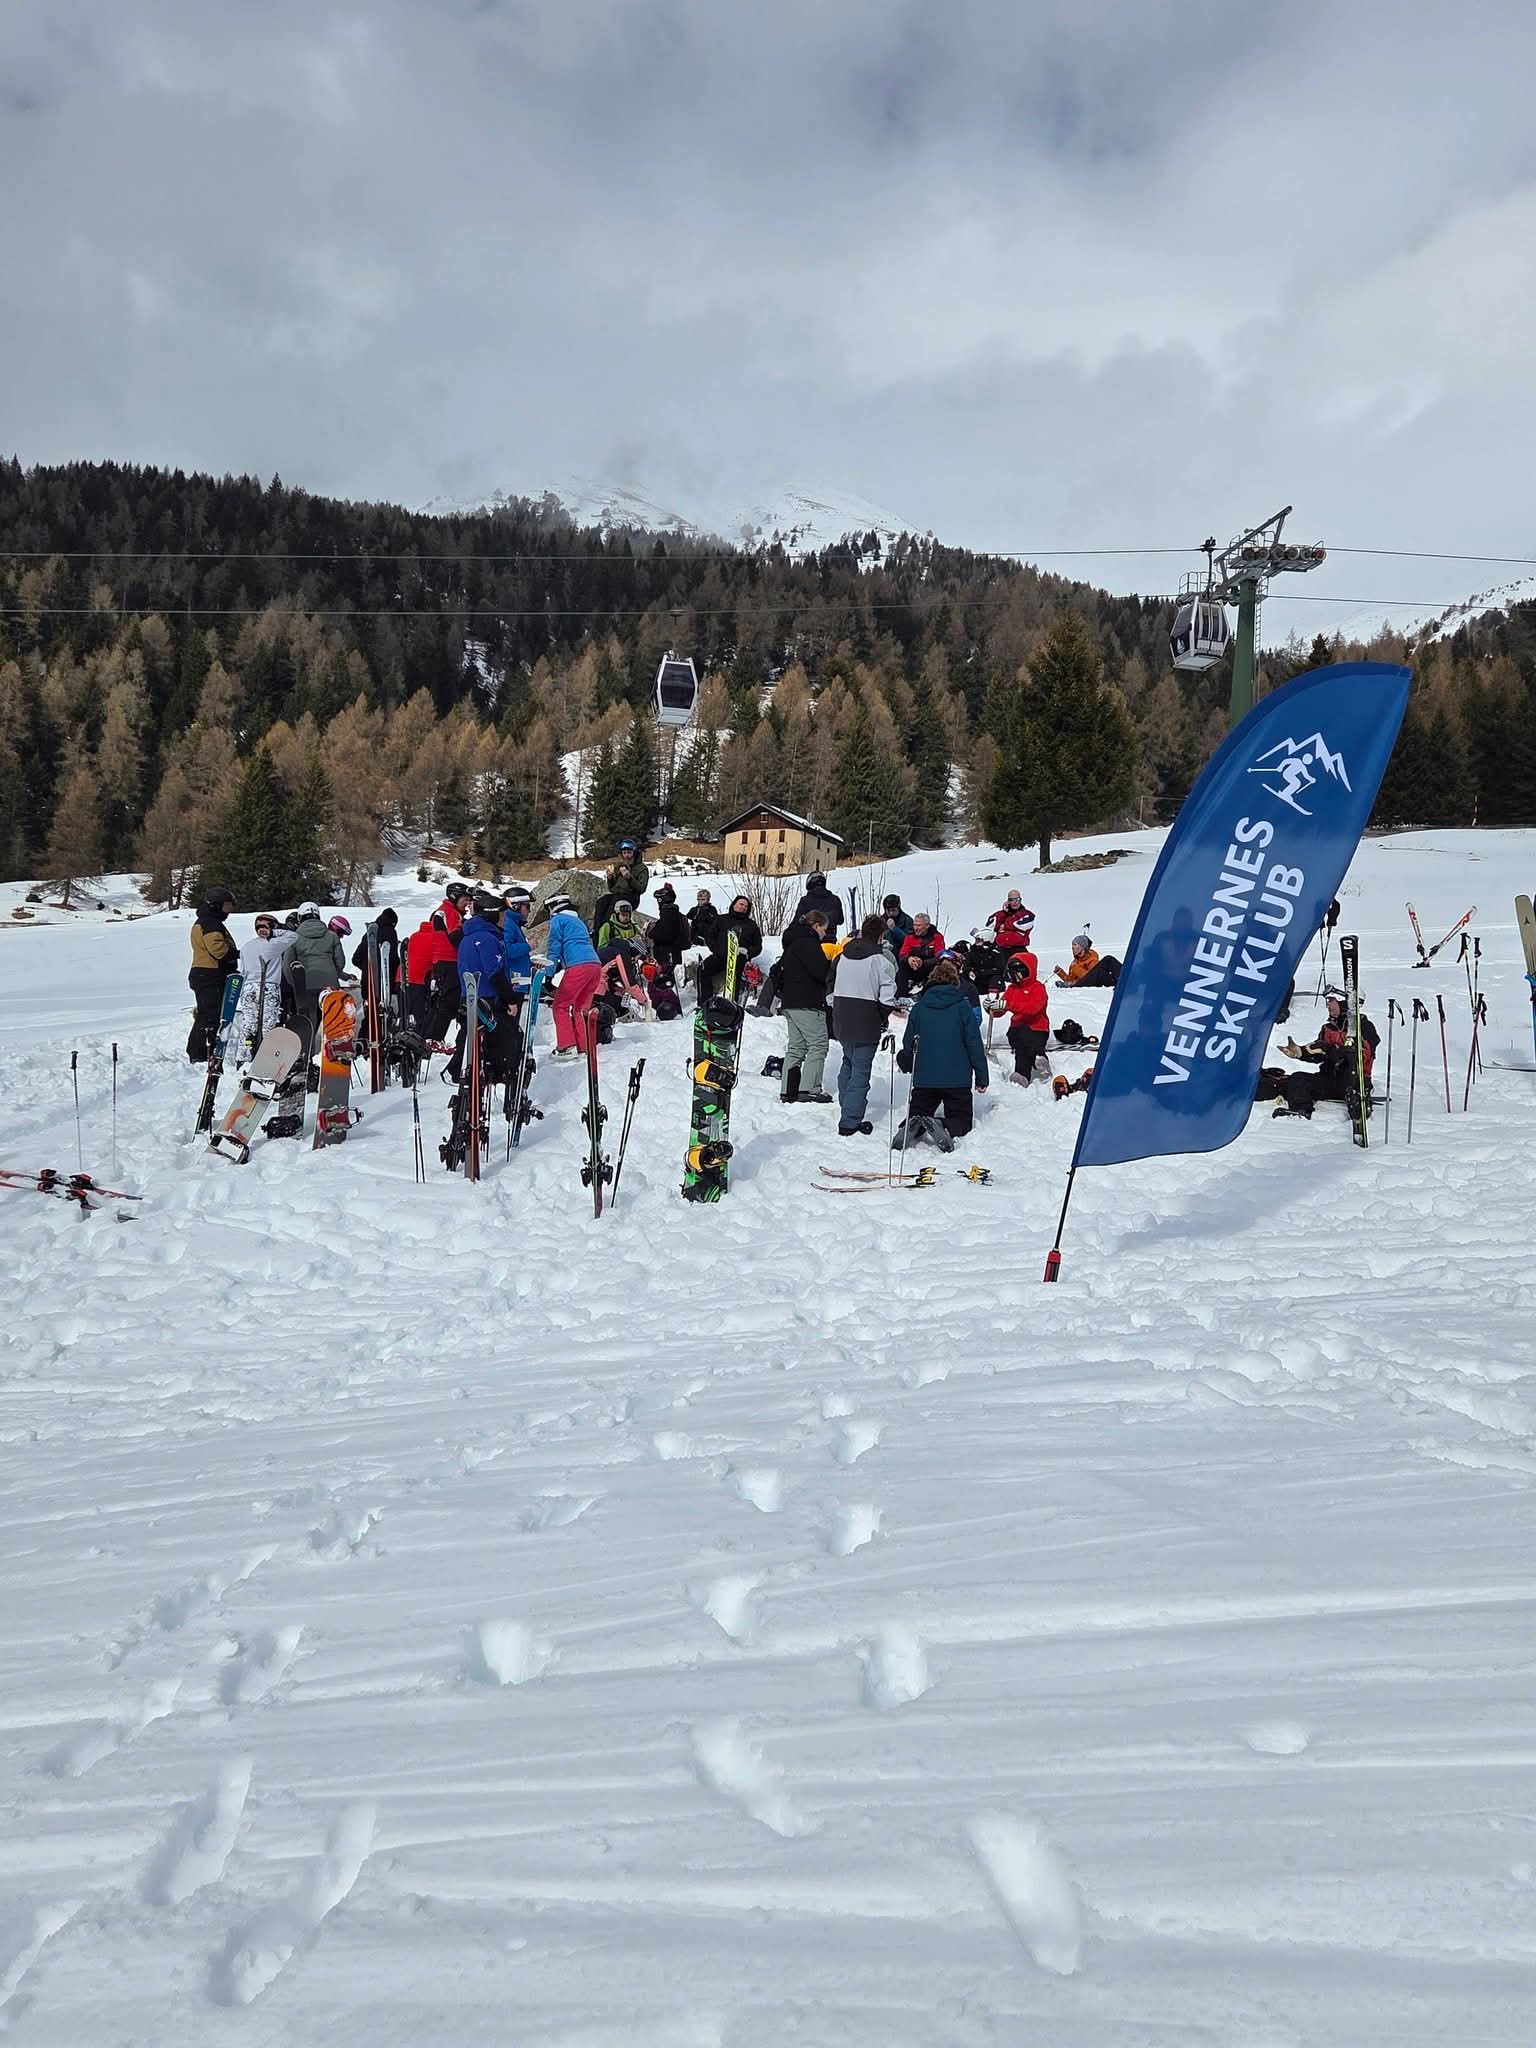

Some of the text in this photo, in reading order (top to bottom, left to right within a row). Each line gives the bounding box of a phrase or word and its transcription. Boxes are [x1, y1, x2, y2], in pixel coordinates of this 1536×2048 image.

[727, 933, 737, 993] FISCHER
[1153, 817, 1274, 1085] VENNERNES
[1204, 864, 1304, 1062] SKI KLUB
